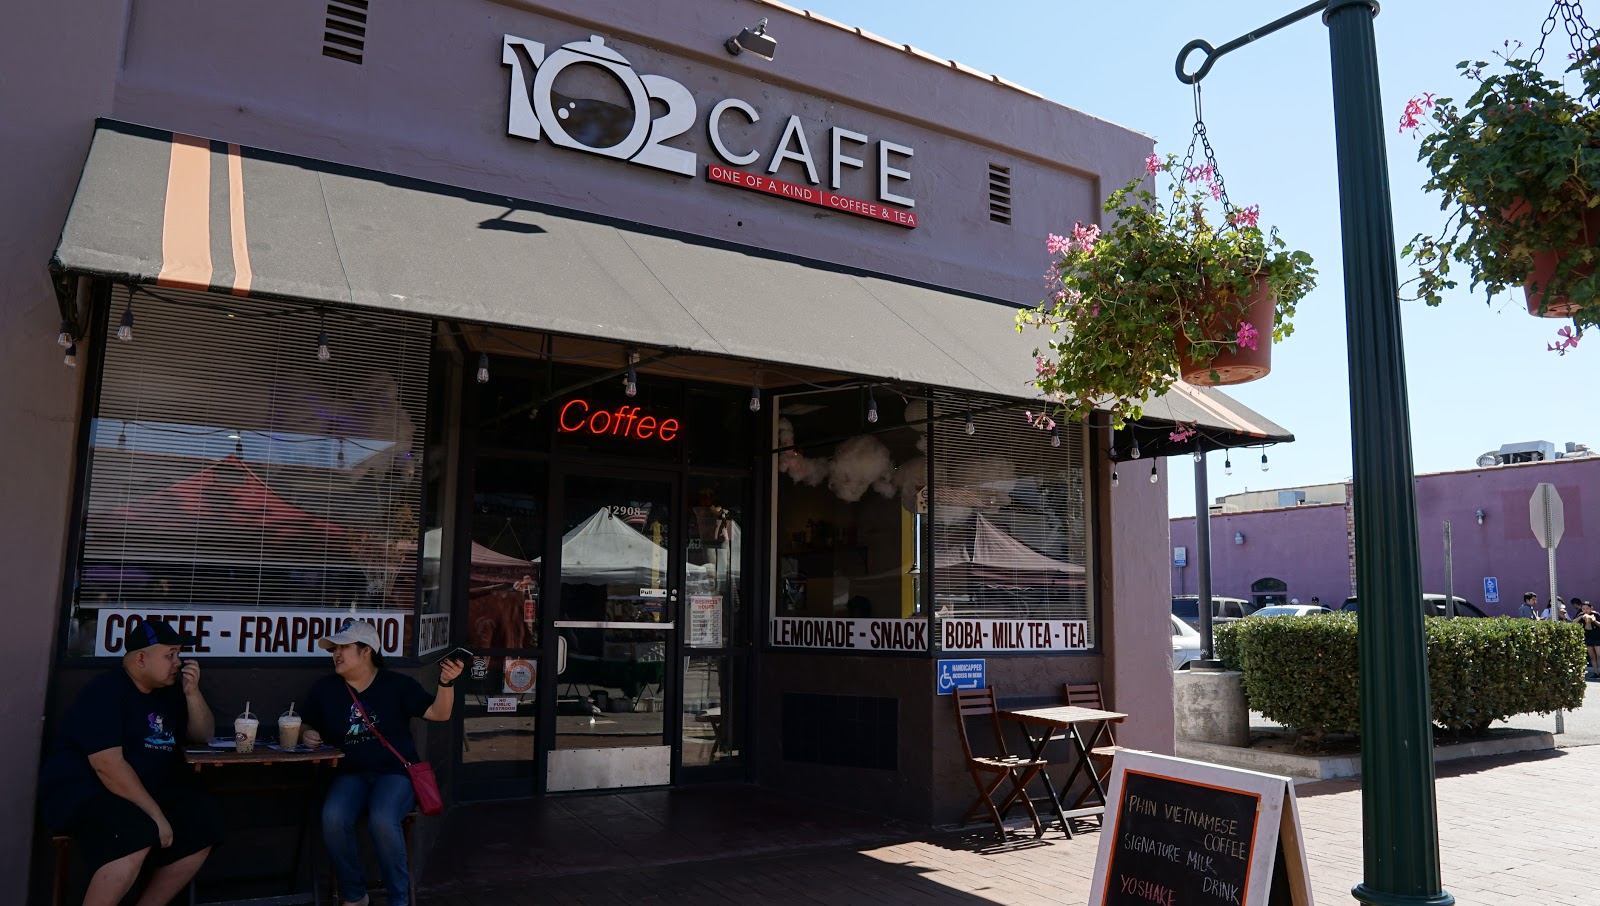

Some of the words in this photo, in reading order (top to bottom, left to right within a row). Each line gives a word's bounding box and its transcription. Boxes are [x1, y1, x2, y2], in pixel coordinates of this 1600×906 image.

[708, 98, 915, 208] CAFE
[712, 167, 740, 183] ONE
[746, 175, 762, 187] OF
[768, 181, 777, 192] A
[782, 183, 812, 199] KIND
[830, 195, 876, 216] COFFEE
[881, 208, 890, 219] &
[894, 211, 915, 225] TEA
[560, 399, 679, 441] Coffee
[607, 504, 642, 516] 12908
[773, 619, 855, 647] LEMONADE
[870, 621, 927, 650] SNACK
[992, 621, 1025, 649] MILK
[1027, 622, 1052, 648] TEA
[1062, 622, 1086, 648] TEA
[951, 663, 983, 672] HANDICAPPED
[1128, 795, 1157, 816] PHIN
[1164, 803, 1238, 836] VIETNAMESE
[1124, 832, 1181, 863] SIGNATURE
[1204, 833, 1246, 860] COFFEE
[1120, 874, 1177, 906] YOSHAKE
[1202, 876, 1240, 906] DRINK
